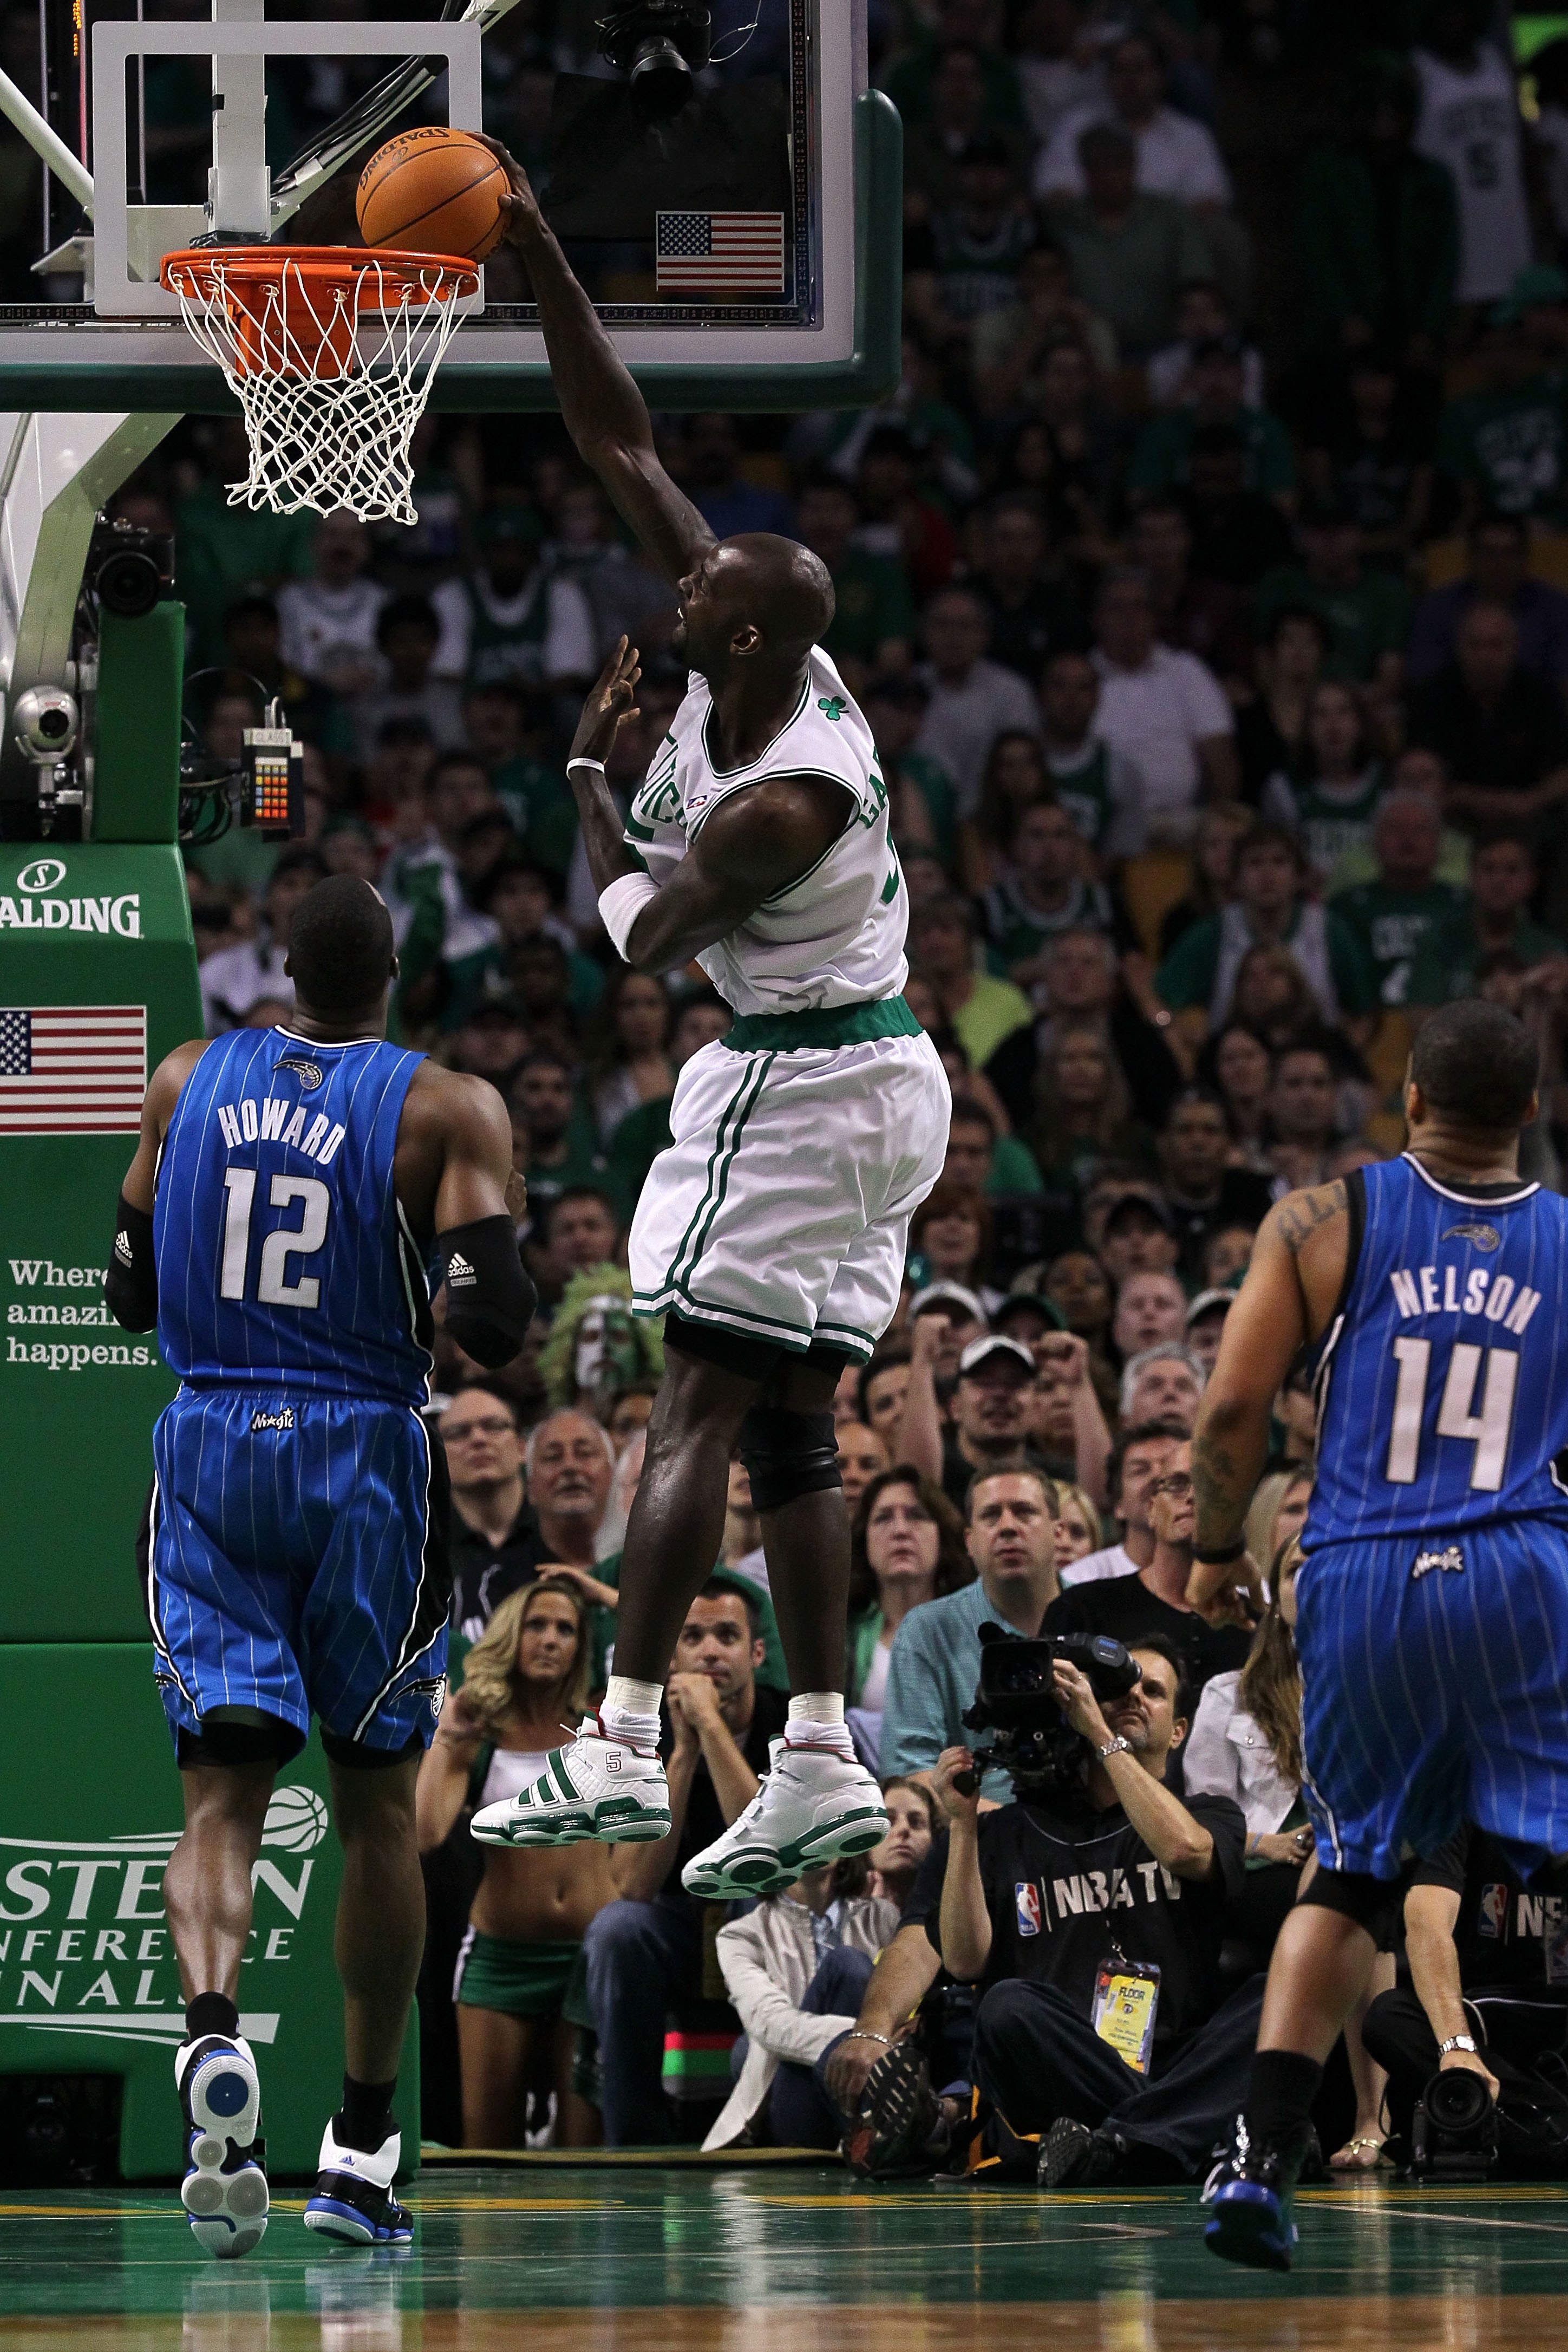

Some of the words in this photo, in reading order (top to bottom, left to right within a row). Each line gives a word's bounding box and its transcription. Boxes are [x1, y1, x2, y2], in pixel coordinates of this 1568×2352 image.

[358, 128, 450, 191] SPALDING
[218, 1097, 346, 1165] HOWARD
[220, 1167, 330, 1309] 12
[448, 1265, 474, 1277] adidas
[1389, 1265, 1542, 1336] NELSON
[6, 1299, 121, 1327] amazi
[6, 1335, 158, 1371] happens.
[1385, 1336, 1520, 1492] 14
[605, 1750, 622, 1773] 5
[0, 1859, 316, 1921] STEN
[1053, 1868, 1135, 1918] NBA
[1136, 1860, 1181, 1904] TV
[1119, 1986, 1145, 2001] FLOOR
